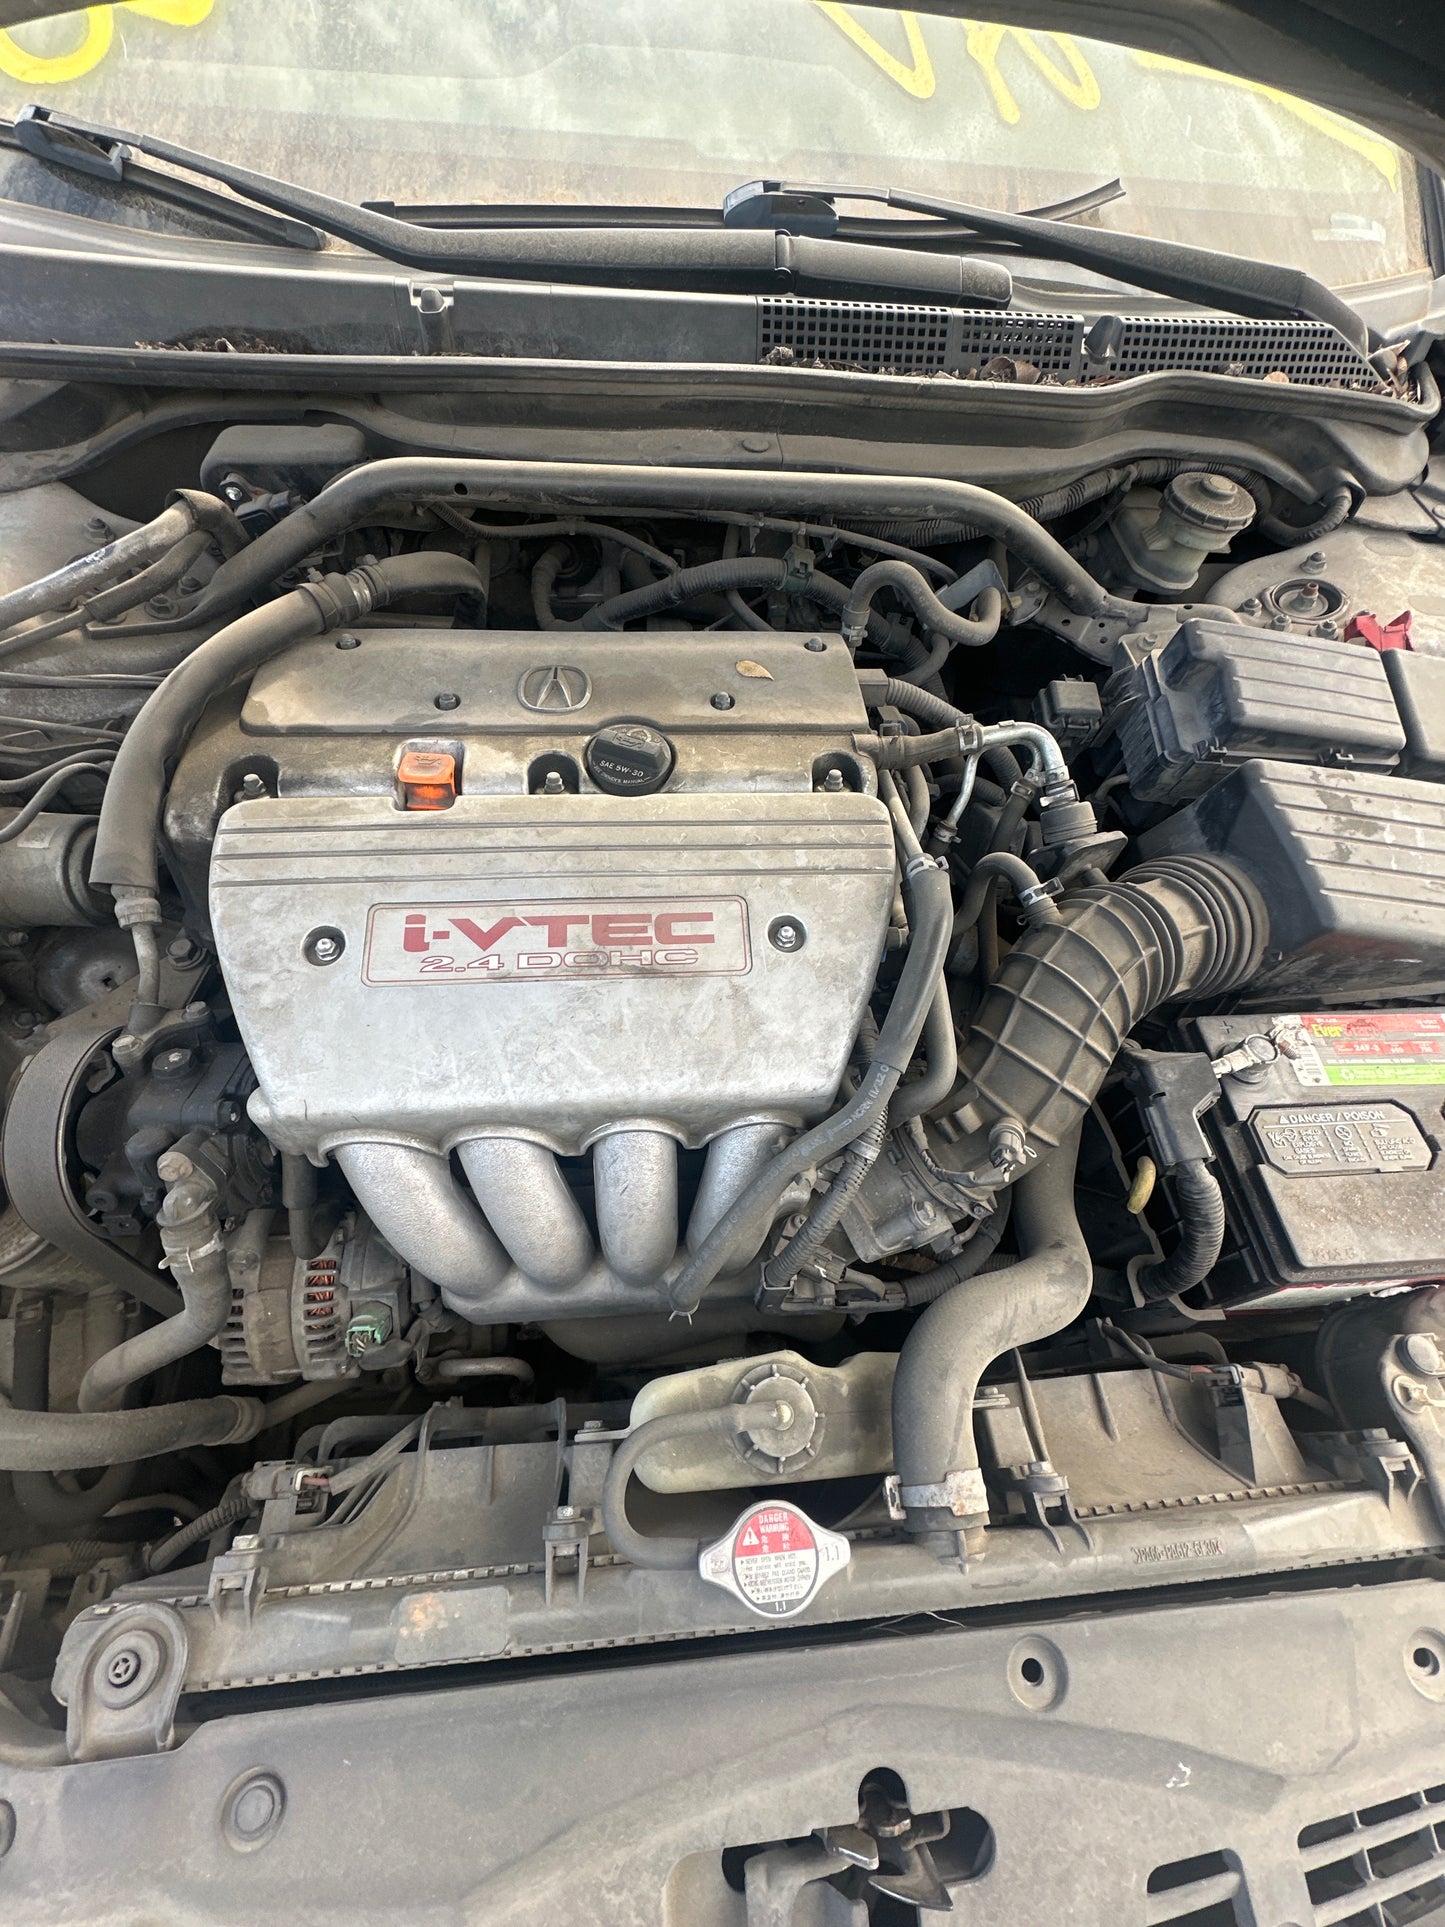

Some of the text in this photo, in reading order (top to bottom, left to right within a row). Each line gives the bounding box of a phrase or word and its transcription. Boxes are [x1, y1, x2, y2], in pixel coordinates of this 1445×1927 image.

[599, 759, 644, 777] SAE 5W-30
[403, 912, 715, 952] i-VTEC
[419, 948, 699, 973] 2.4 DOHC
[1289, 1112, 1335, 1123] DANGER
[1343, 1110, 1386, 1121] POISON
[759, 1511, 788, 1524] DANGER
[825, 1545, 840, 1562] 1.1
[774, 1601, 787, 1612] 1.1
